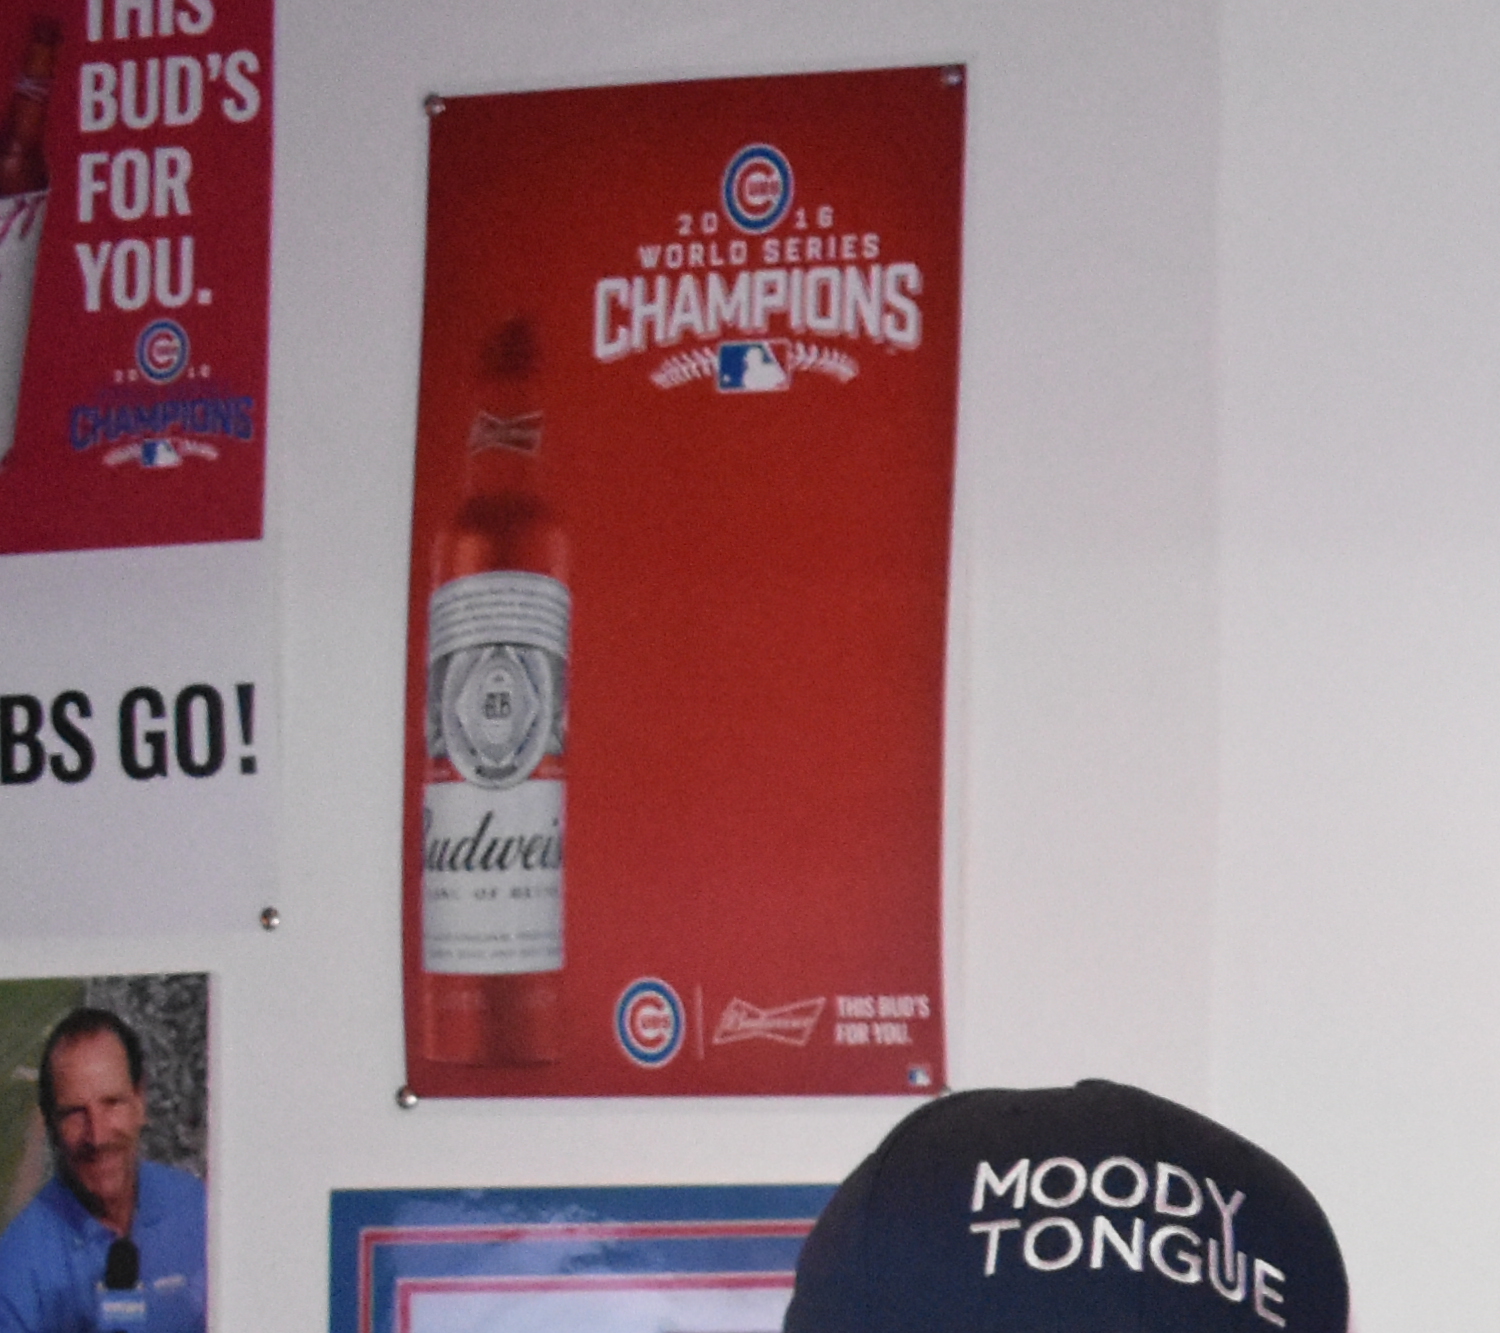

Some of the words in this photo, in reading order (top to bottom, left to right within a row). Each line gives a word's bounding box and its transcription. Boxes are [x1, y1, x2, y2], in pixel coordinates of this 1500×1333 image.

[79, 50, 261, 133] BUD'S
[78, 146, 193, 223] FOR
[677, 212, 719, 236] 20
[795, 205, 834, 229] 16
[75, 236, 213, 312] YOU.
[639, 240, 748, 269] WORLD
[763, 233, 880, 263] SERIES
[594, 262, 923, 362] CHAMPIONS
[70, 396, 254, 451] CHAMPIONS
[118, 682, 257, 781] GO!
[970, 1156, 1246, 1280] MOODY
[969, 1216, 1287, 1328] TONGUE
